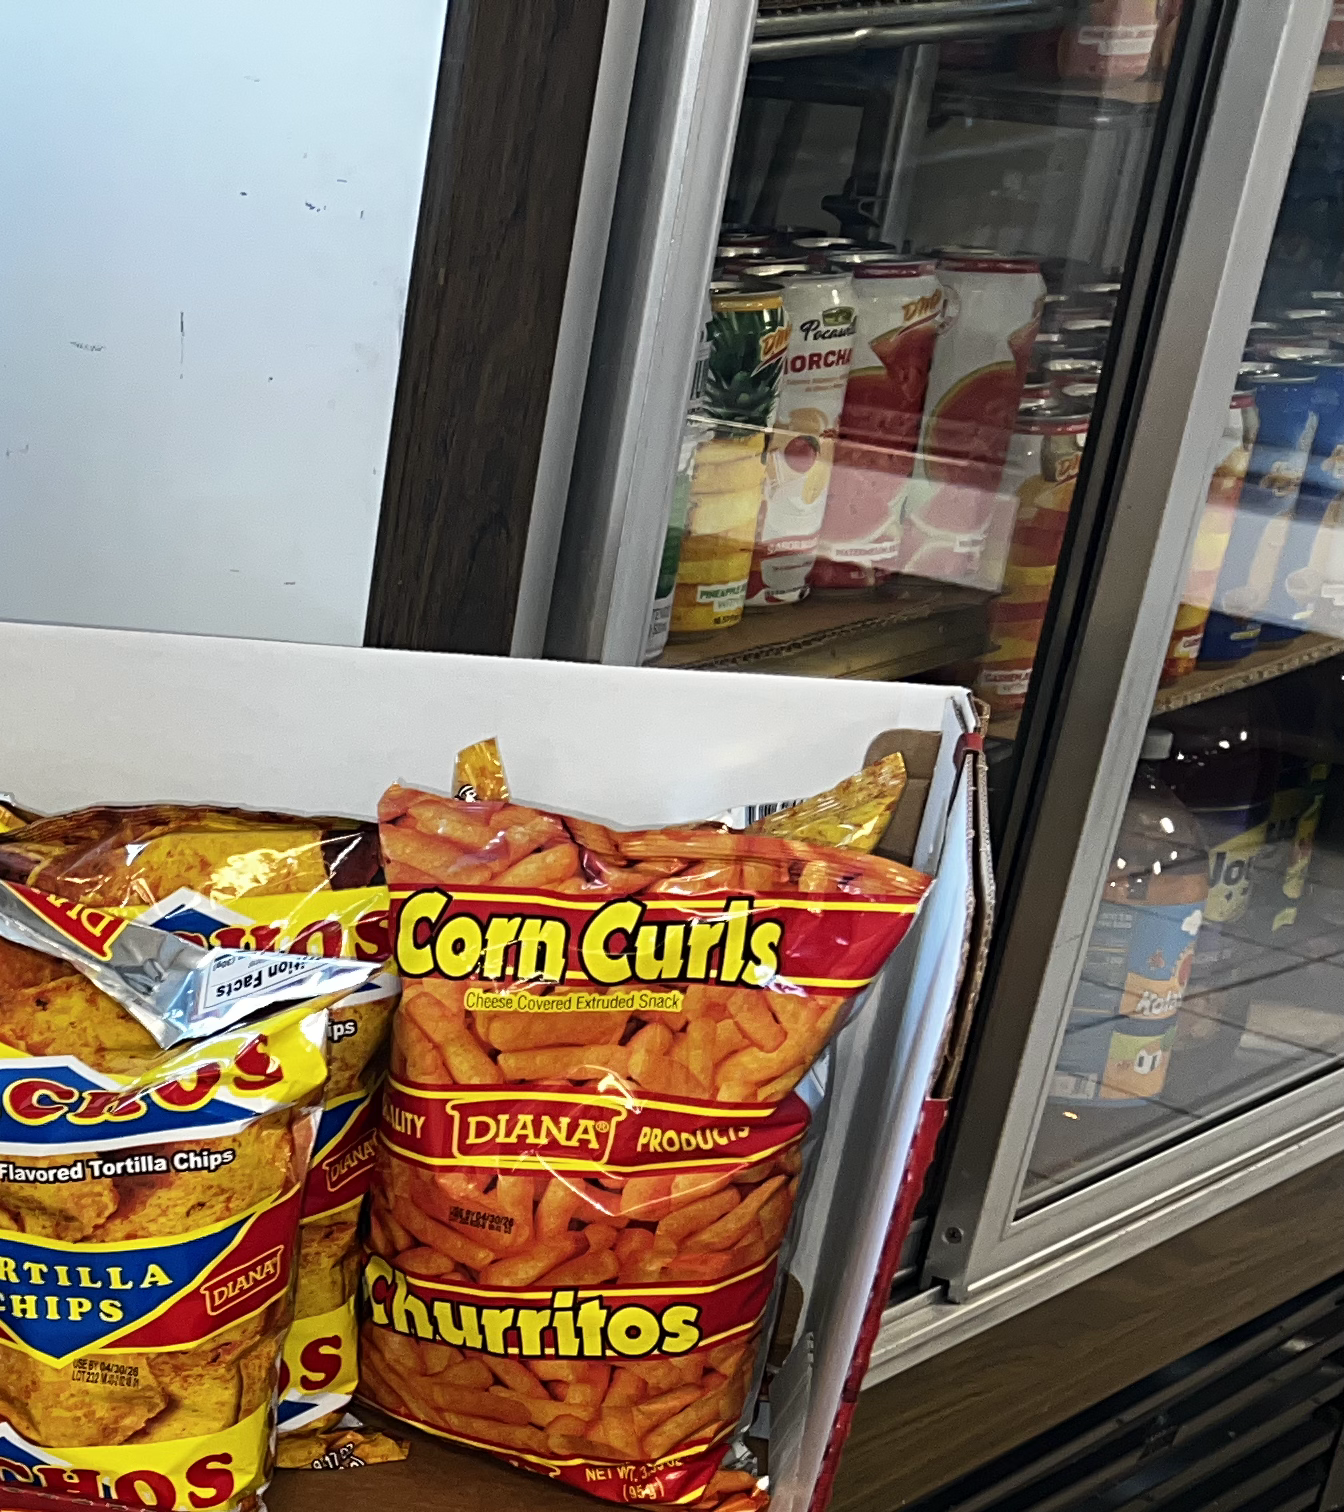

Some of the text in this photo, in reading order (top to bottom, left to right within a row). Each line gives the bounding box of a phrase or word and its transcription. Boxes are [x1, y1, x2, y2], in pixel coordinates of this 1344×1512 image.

[397, 892, 782, 986] Corn Curls
[466, 991, 680, 1012] Cheese Covered Extruded Snack
[89, 1153, 168, 1177] Tortilla
[173, 1147, 235, 1172] Chips
[212, 1260, 279, 1310] DIANA
[364, 1256, 703, 1358] Churritos
